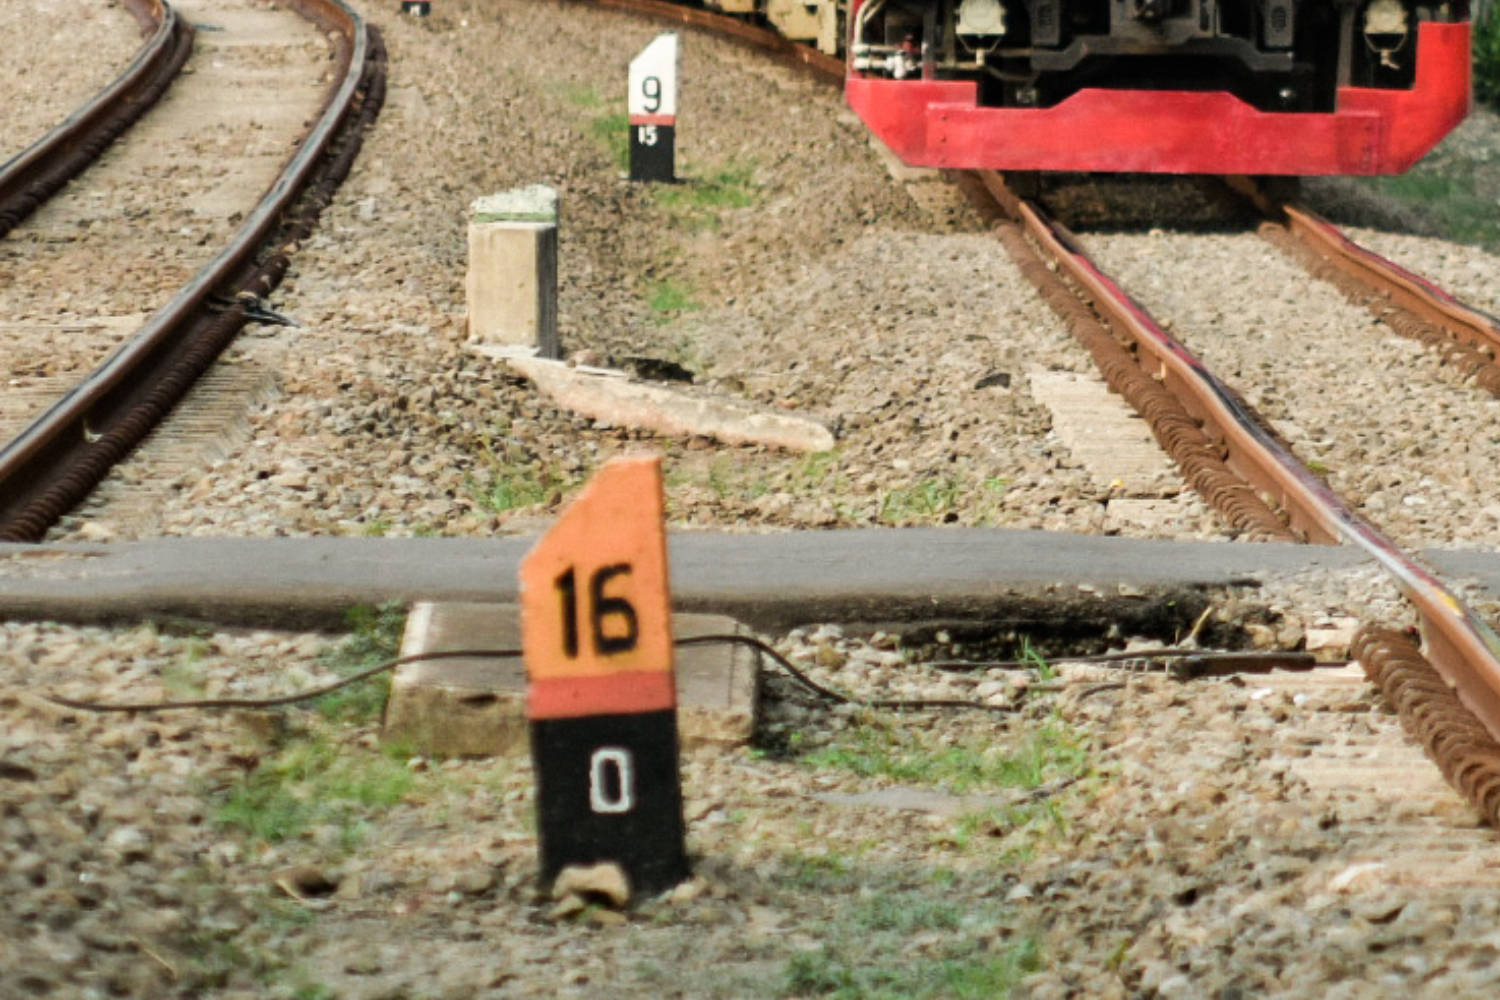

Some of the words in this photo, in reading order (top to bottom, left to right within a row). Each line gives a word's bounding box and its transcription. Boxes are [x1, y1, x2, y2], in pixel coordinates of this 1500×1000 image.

[642, 76, 662, 113] 9
[637, 125, 657, 146] 15
[554, 562, 639, 659] 16
[590, 746, 632, 814] 0
